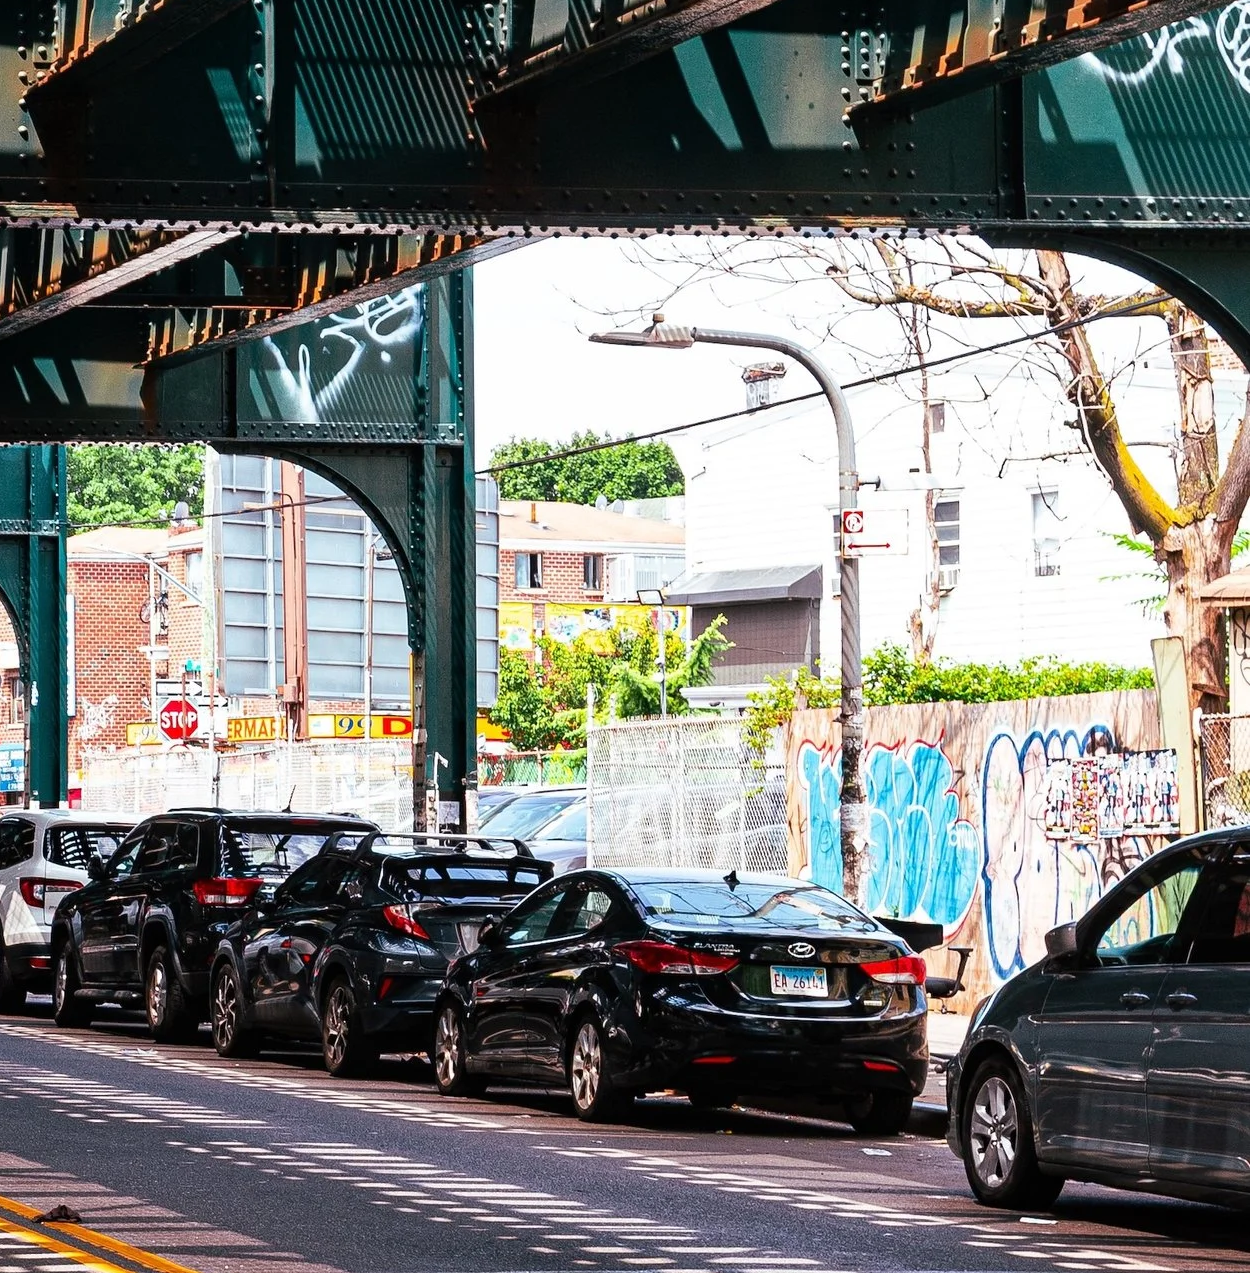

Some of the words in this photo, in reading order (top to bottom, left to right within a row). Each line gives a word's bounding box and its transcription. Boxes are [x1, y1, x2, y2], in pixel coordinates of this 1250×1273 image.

[161, 712, 197, 728] STOP
[774, 974, 787, 988] EA
[793, 975, 825, 989] 26141
